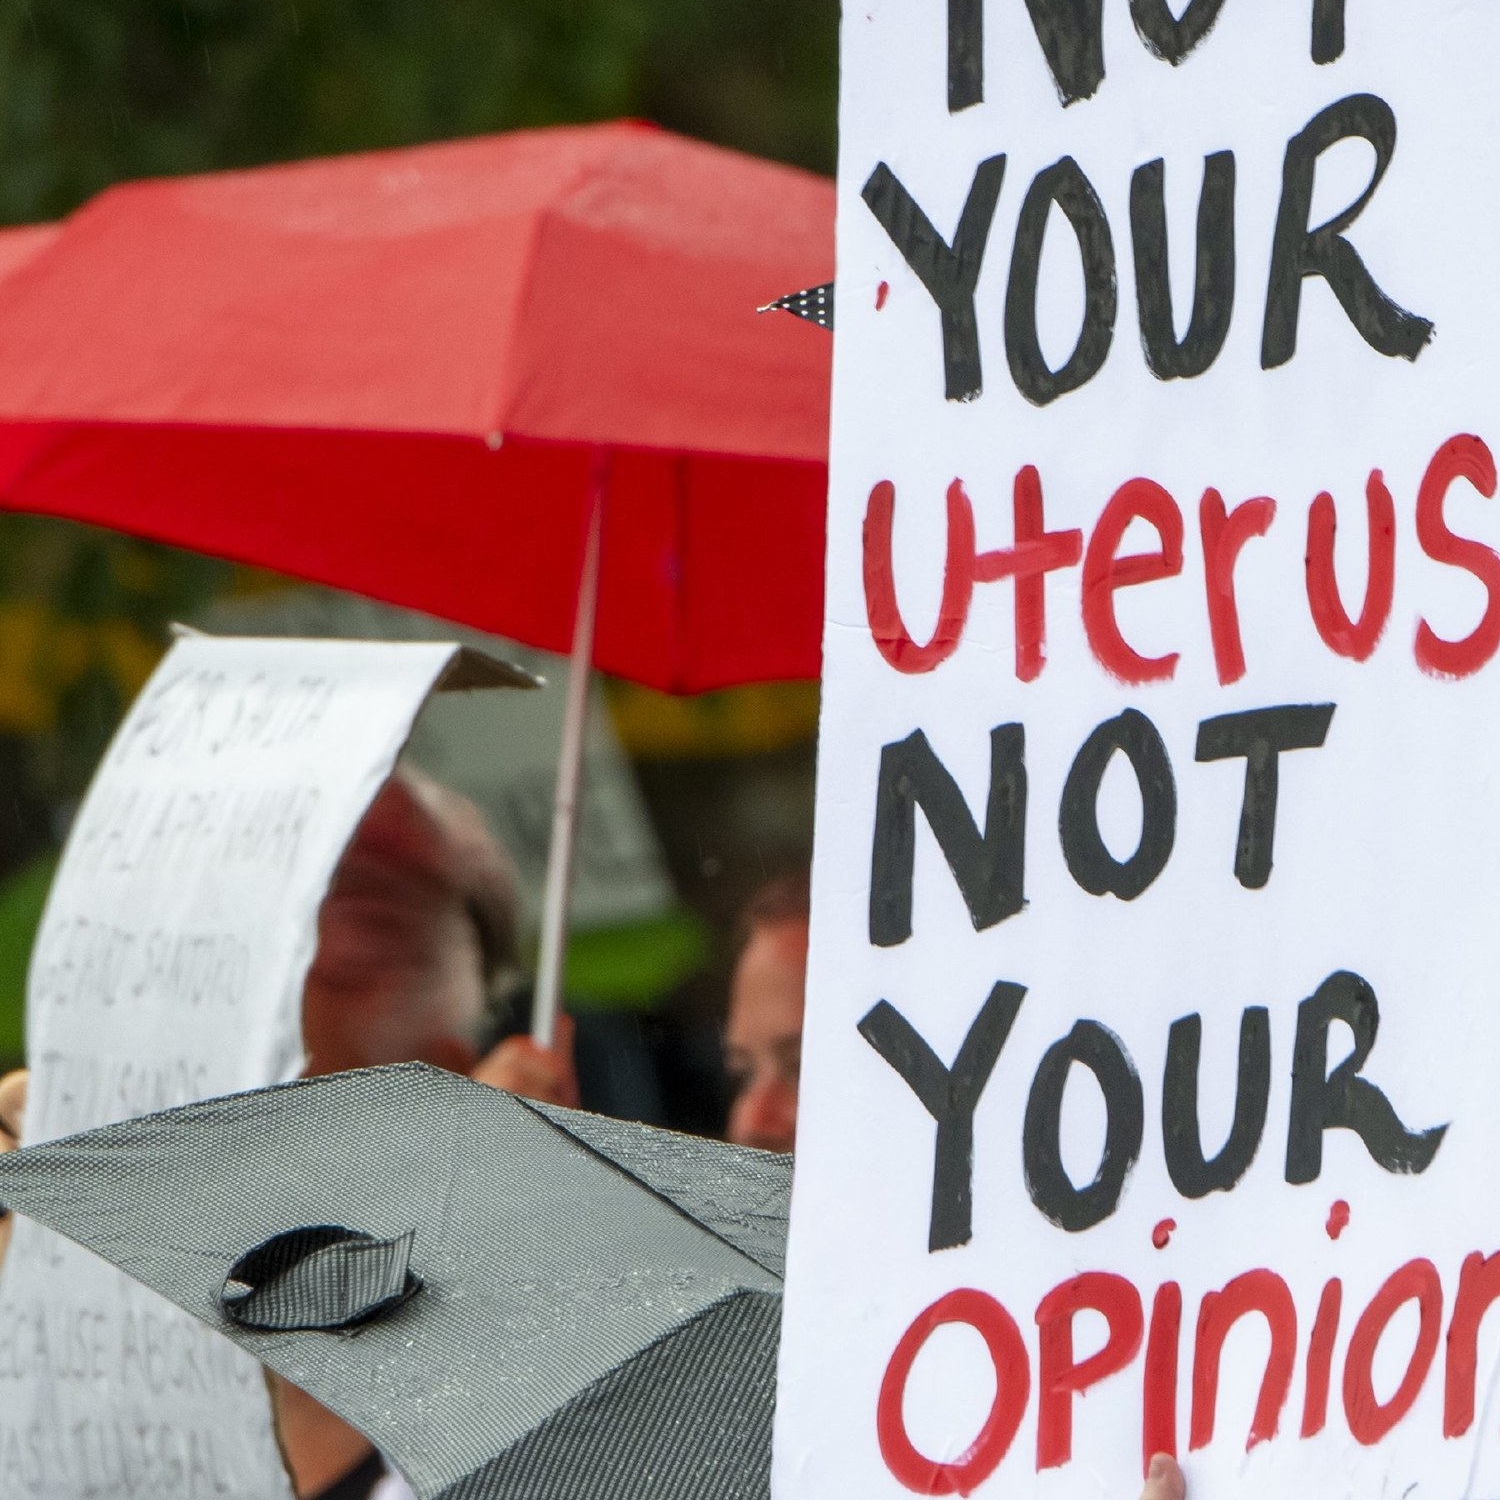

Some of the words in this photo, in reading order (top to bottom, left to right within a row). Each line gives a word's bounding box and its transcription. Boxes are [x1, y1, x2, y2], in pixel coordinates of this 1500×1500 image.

[860, 92, 1436, 406] YOUR
[868, 702, 1337, 948] NOT
[857, 970, 1450, 1254] YOUR
